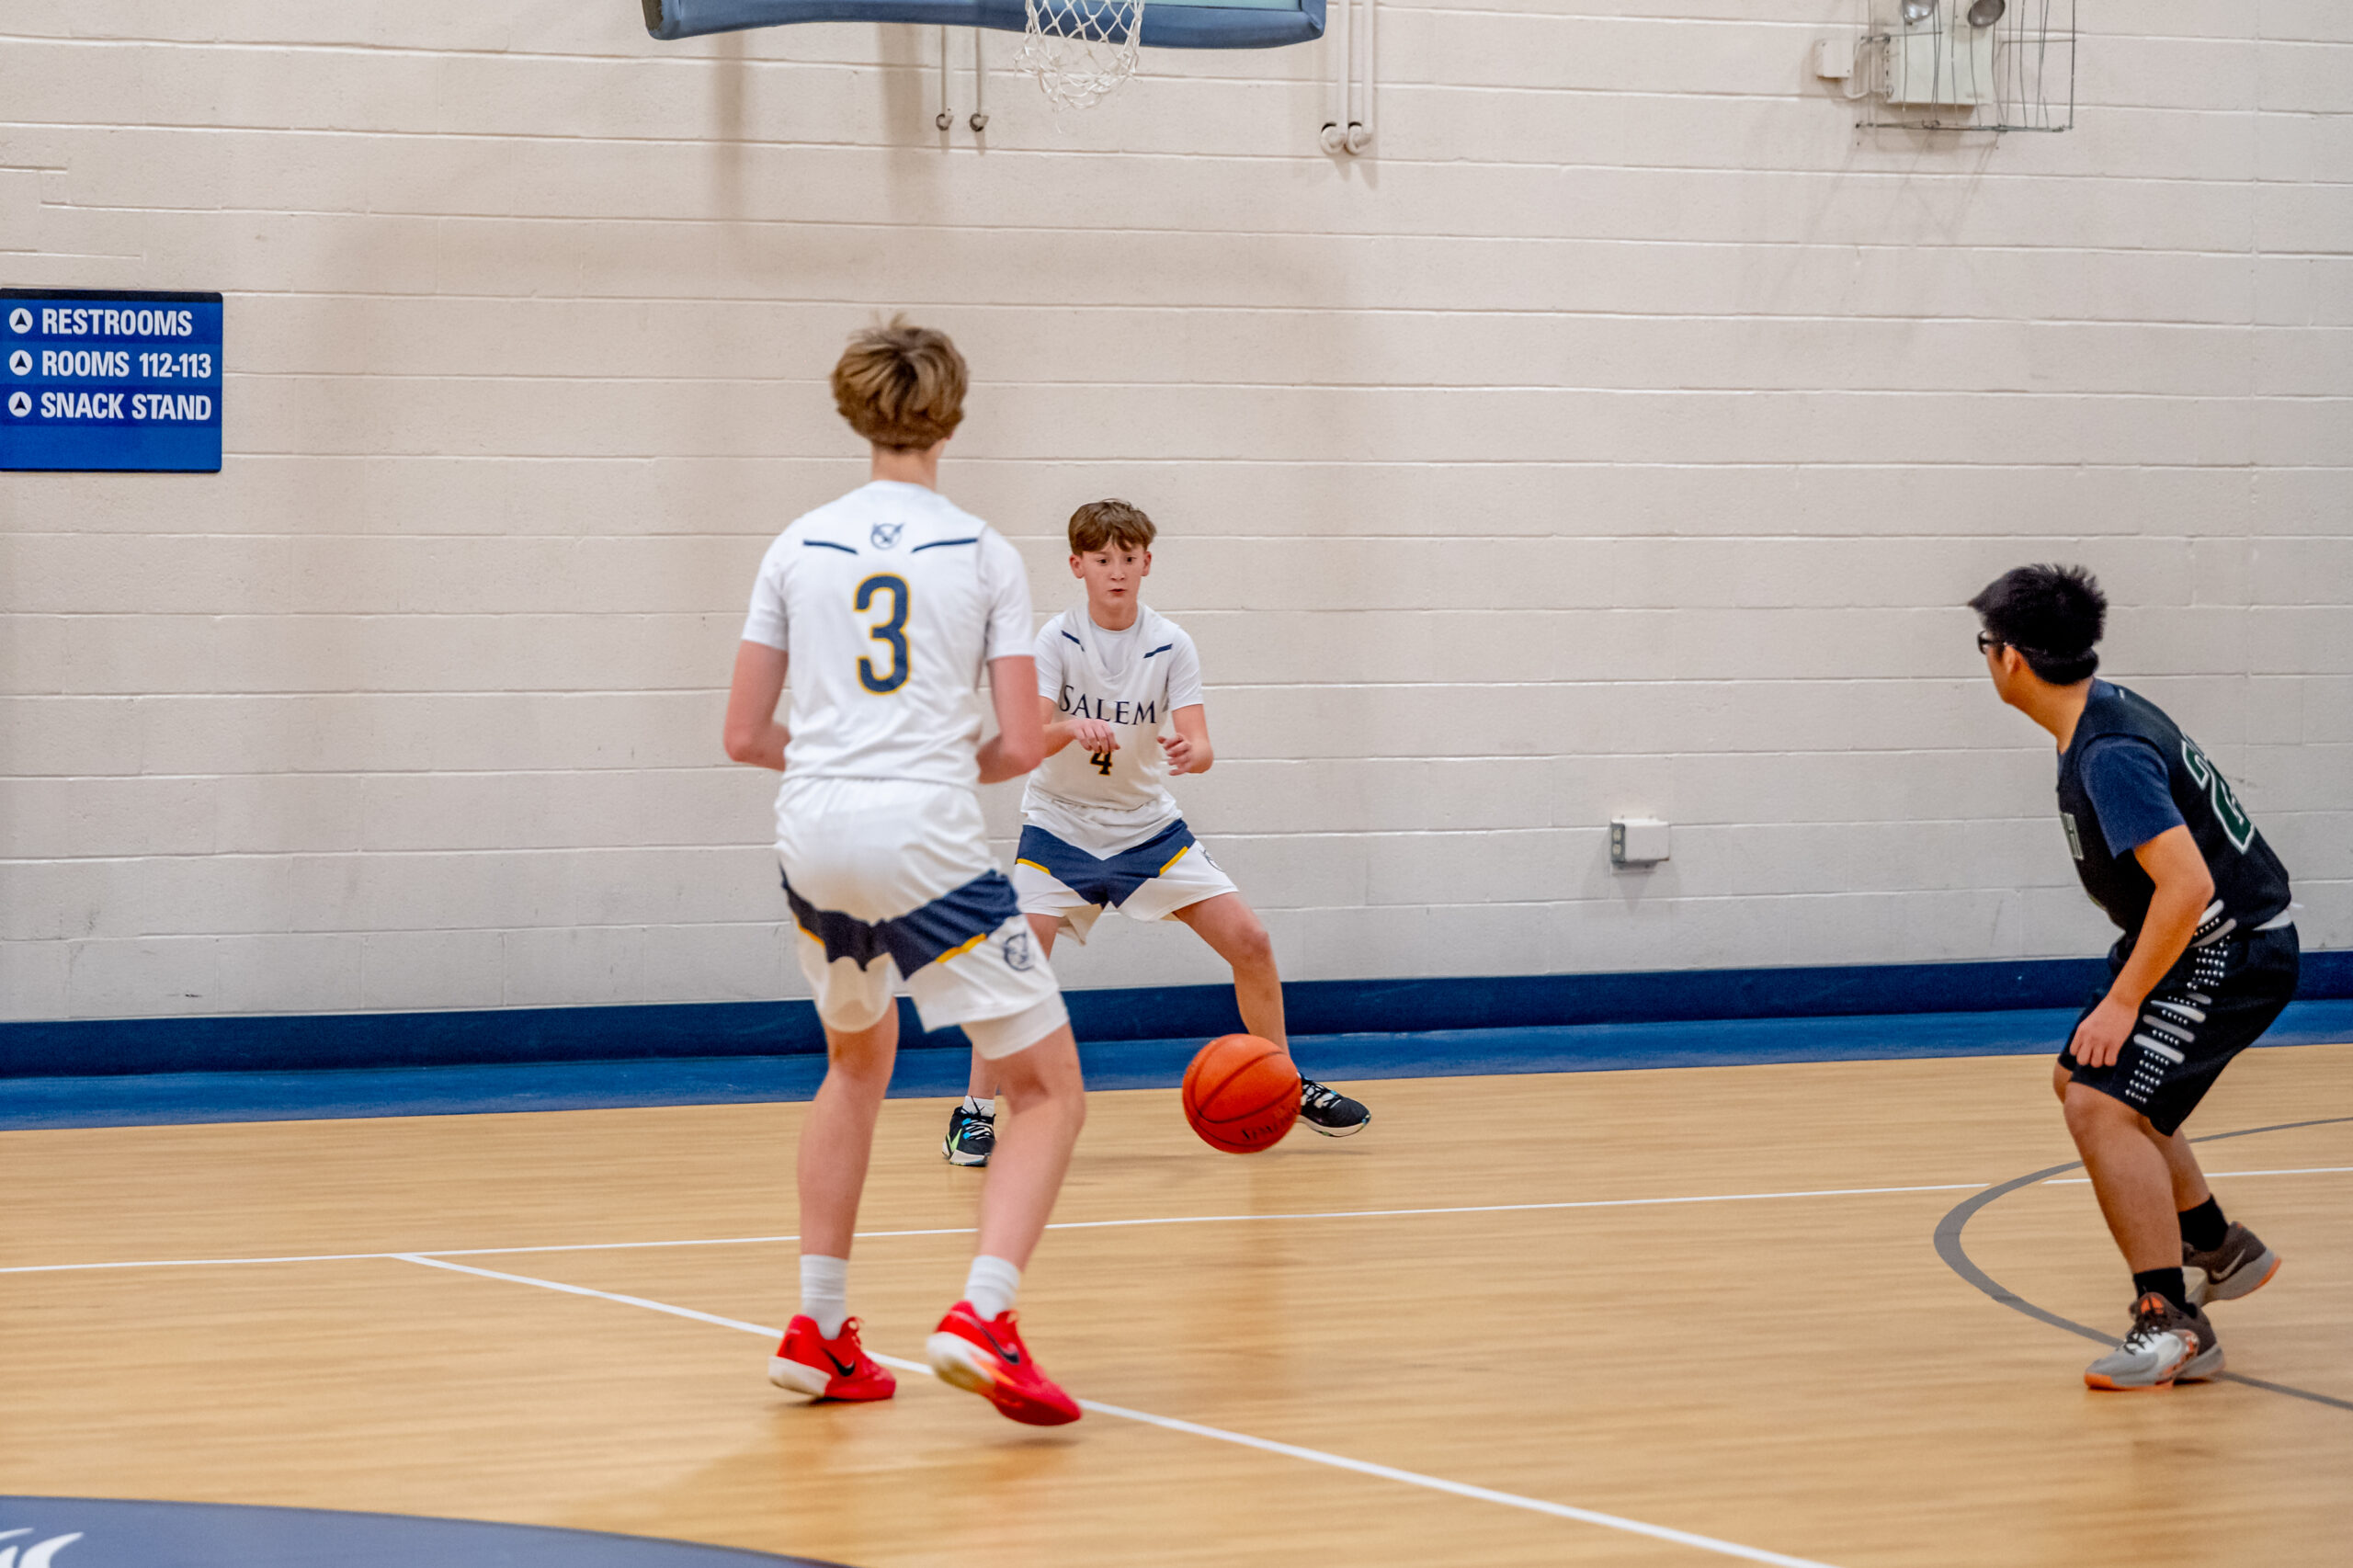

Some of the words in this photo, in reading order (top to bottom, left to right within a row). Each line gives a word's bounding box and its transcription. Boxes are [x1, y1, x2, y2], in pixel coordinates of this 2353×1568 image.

[42, 308, 193, 336] RESTROOMS
[42, 350, 130, 378] ROOMS
[139, 353, 211, 378] 112-113
[40, 392, 124, 419] SNACK
[131, 393, 211, 420] STAND
[853, 572, 911, 695] 3
[1059, 684, 1157, 725] SALEM
[1089, 742, 1113, 776] 4
